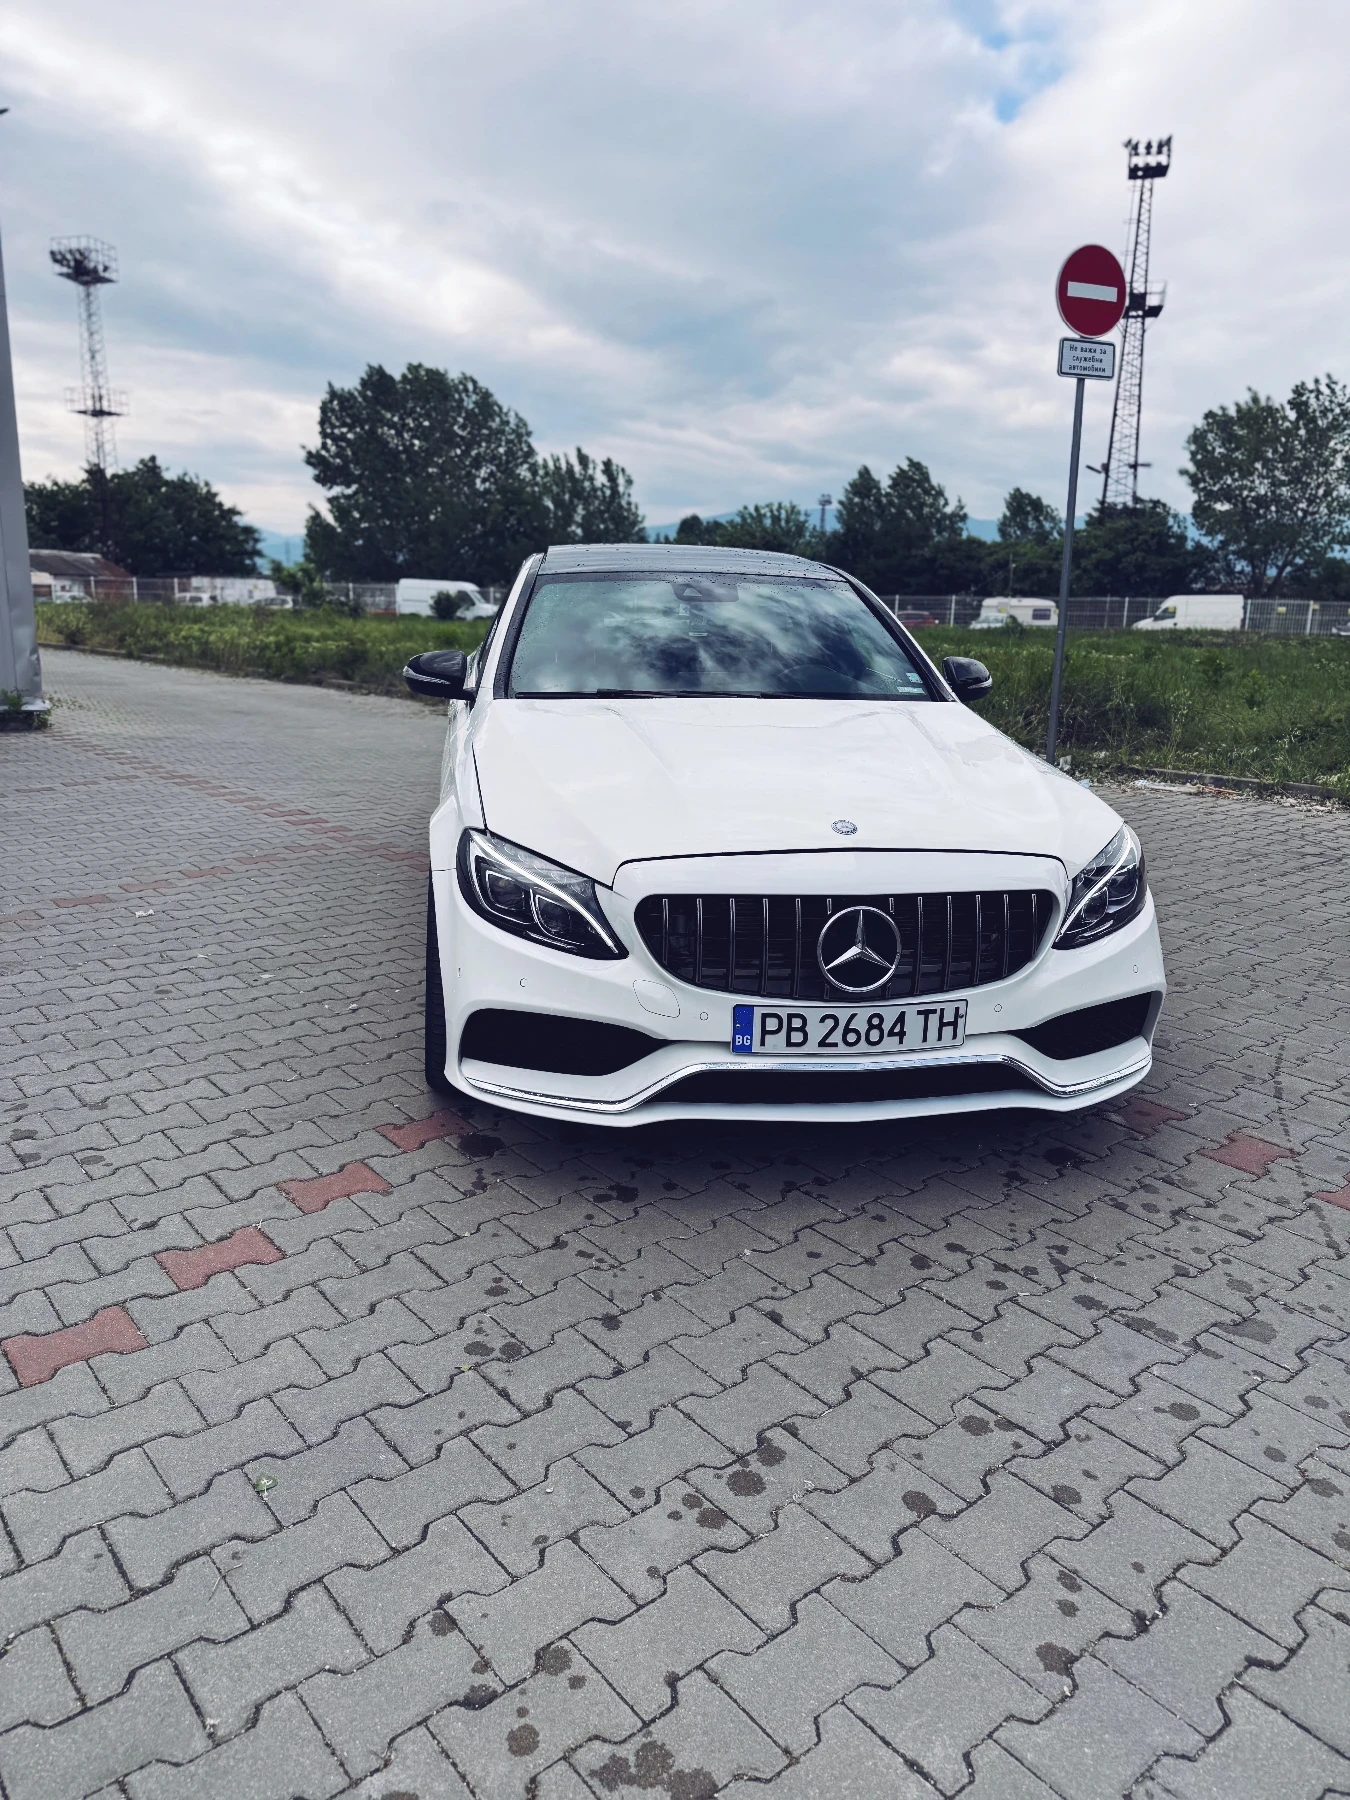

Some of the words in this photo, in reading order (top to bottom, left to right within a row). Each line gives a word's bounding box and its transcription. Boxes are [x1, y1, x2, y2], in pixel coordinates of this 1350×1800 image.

[1069, 344, 1078, 352] Не
[759, 1012, 809, 1048] PB
[817, 1010, 907, 1048] 2684
[916, 1006, 960, 1044] TH
[735, 1034, 751, 1046] BG
